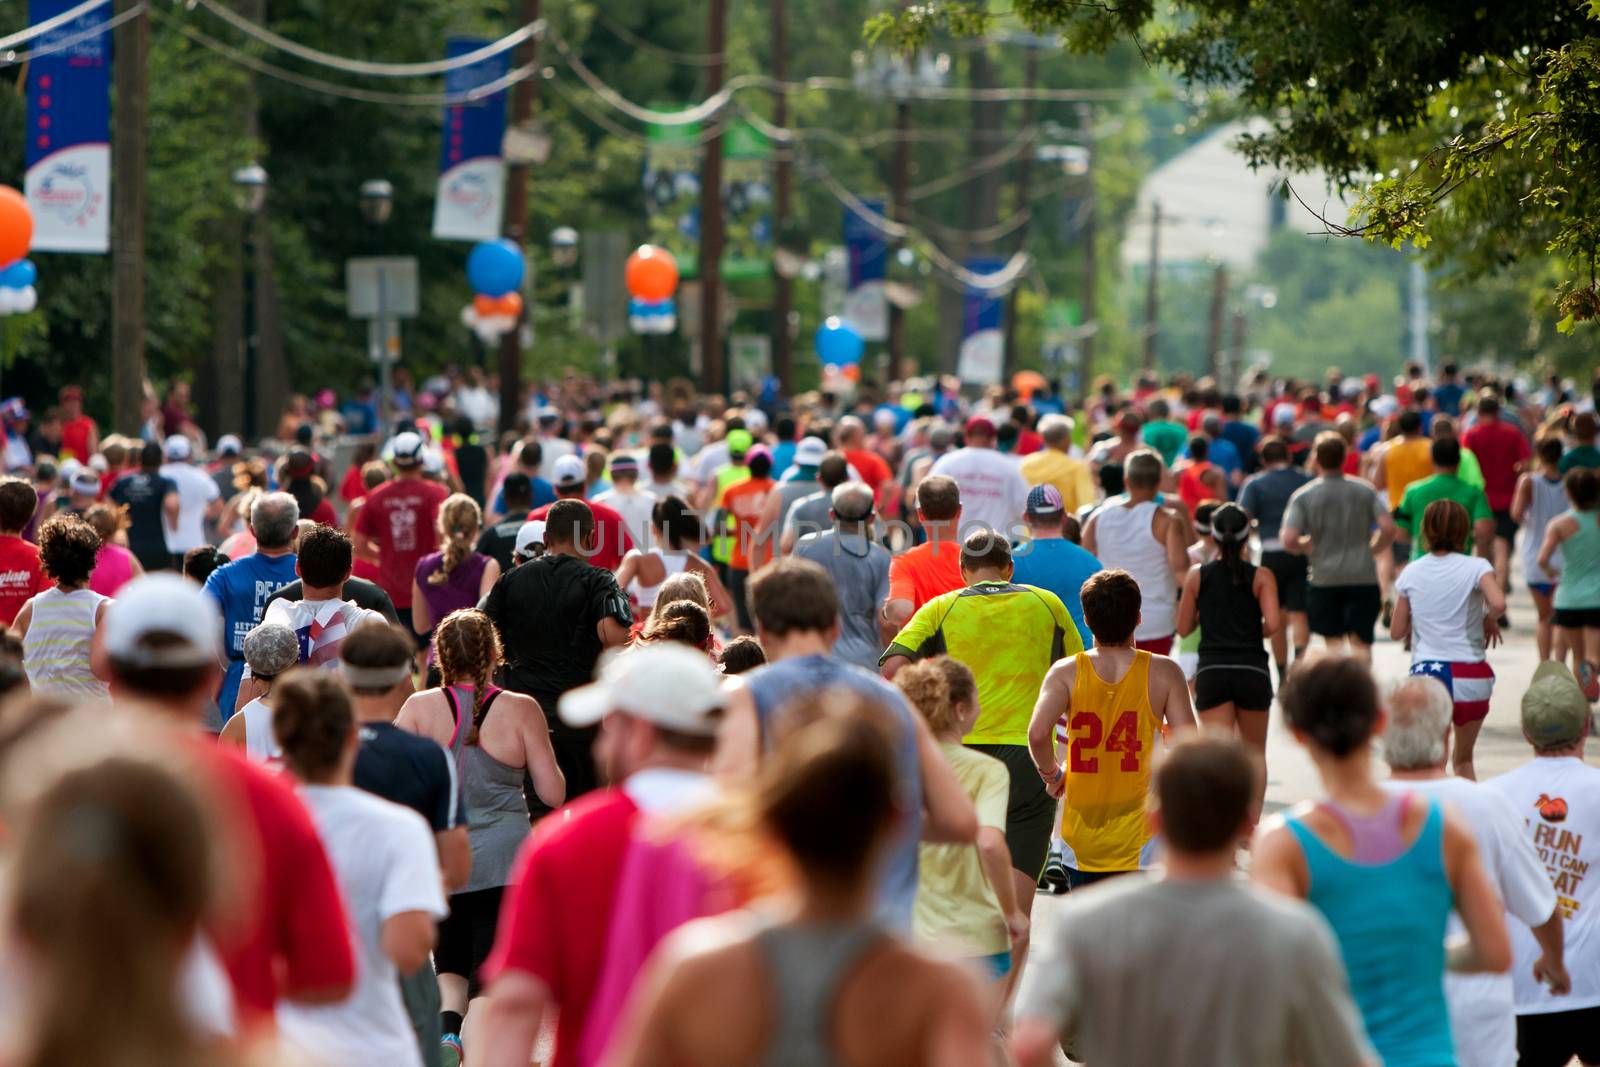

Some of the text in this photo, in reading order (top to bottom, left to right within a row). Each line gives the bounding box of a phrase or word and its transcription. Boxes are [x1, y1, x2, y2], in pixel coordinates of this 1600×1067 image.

[1071, 710, 1142, 773] 24
[1534, 823, 1582, 856] RUN
[1560, 854, 1589, 875] CAN
